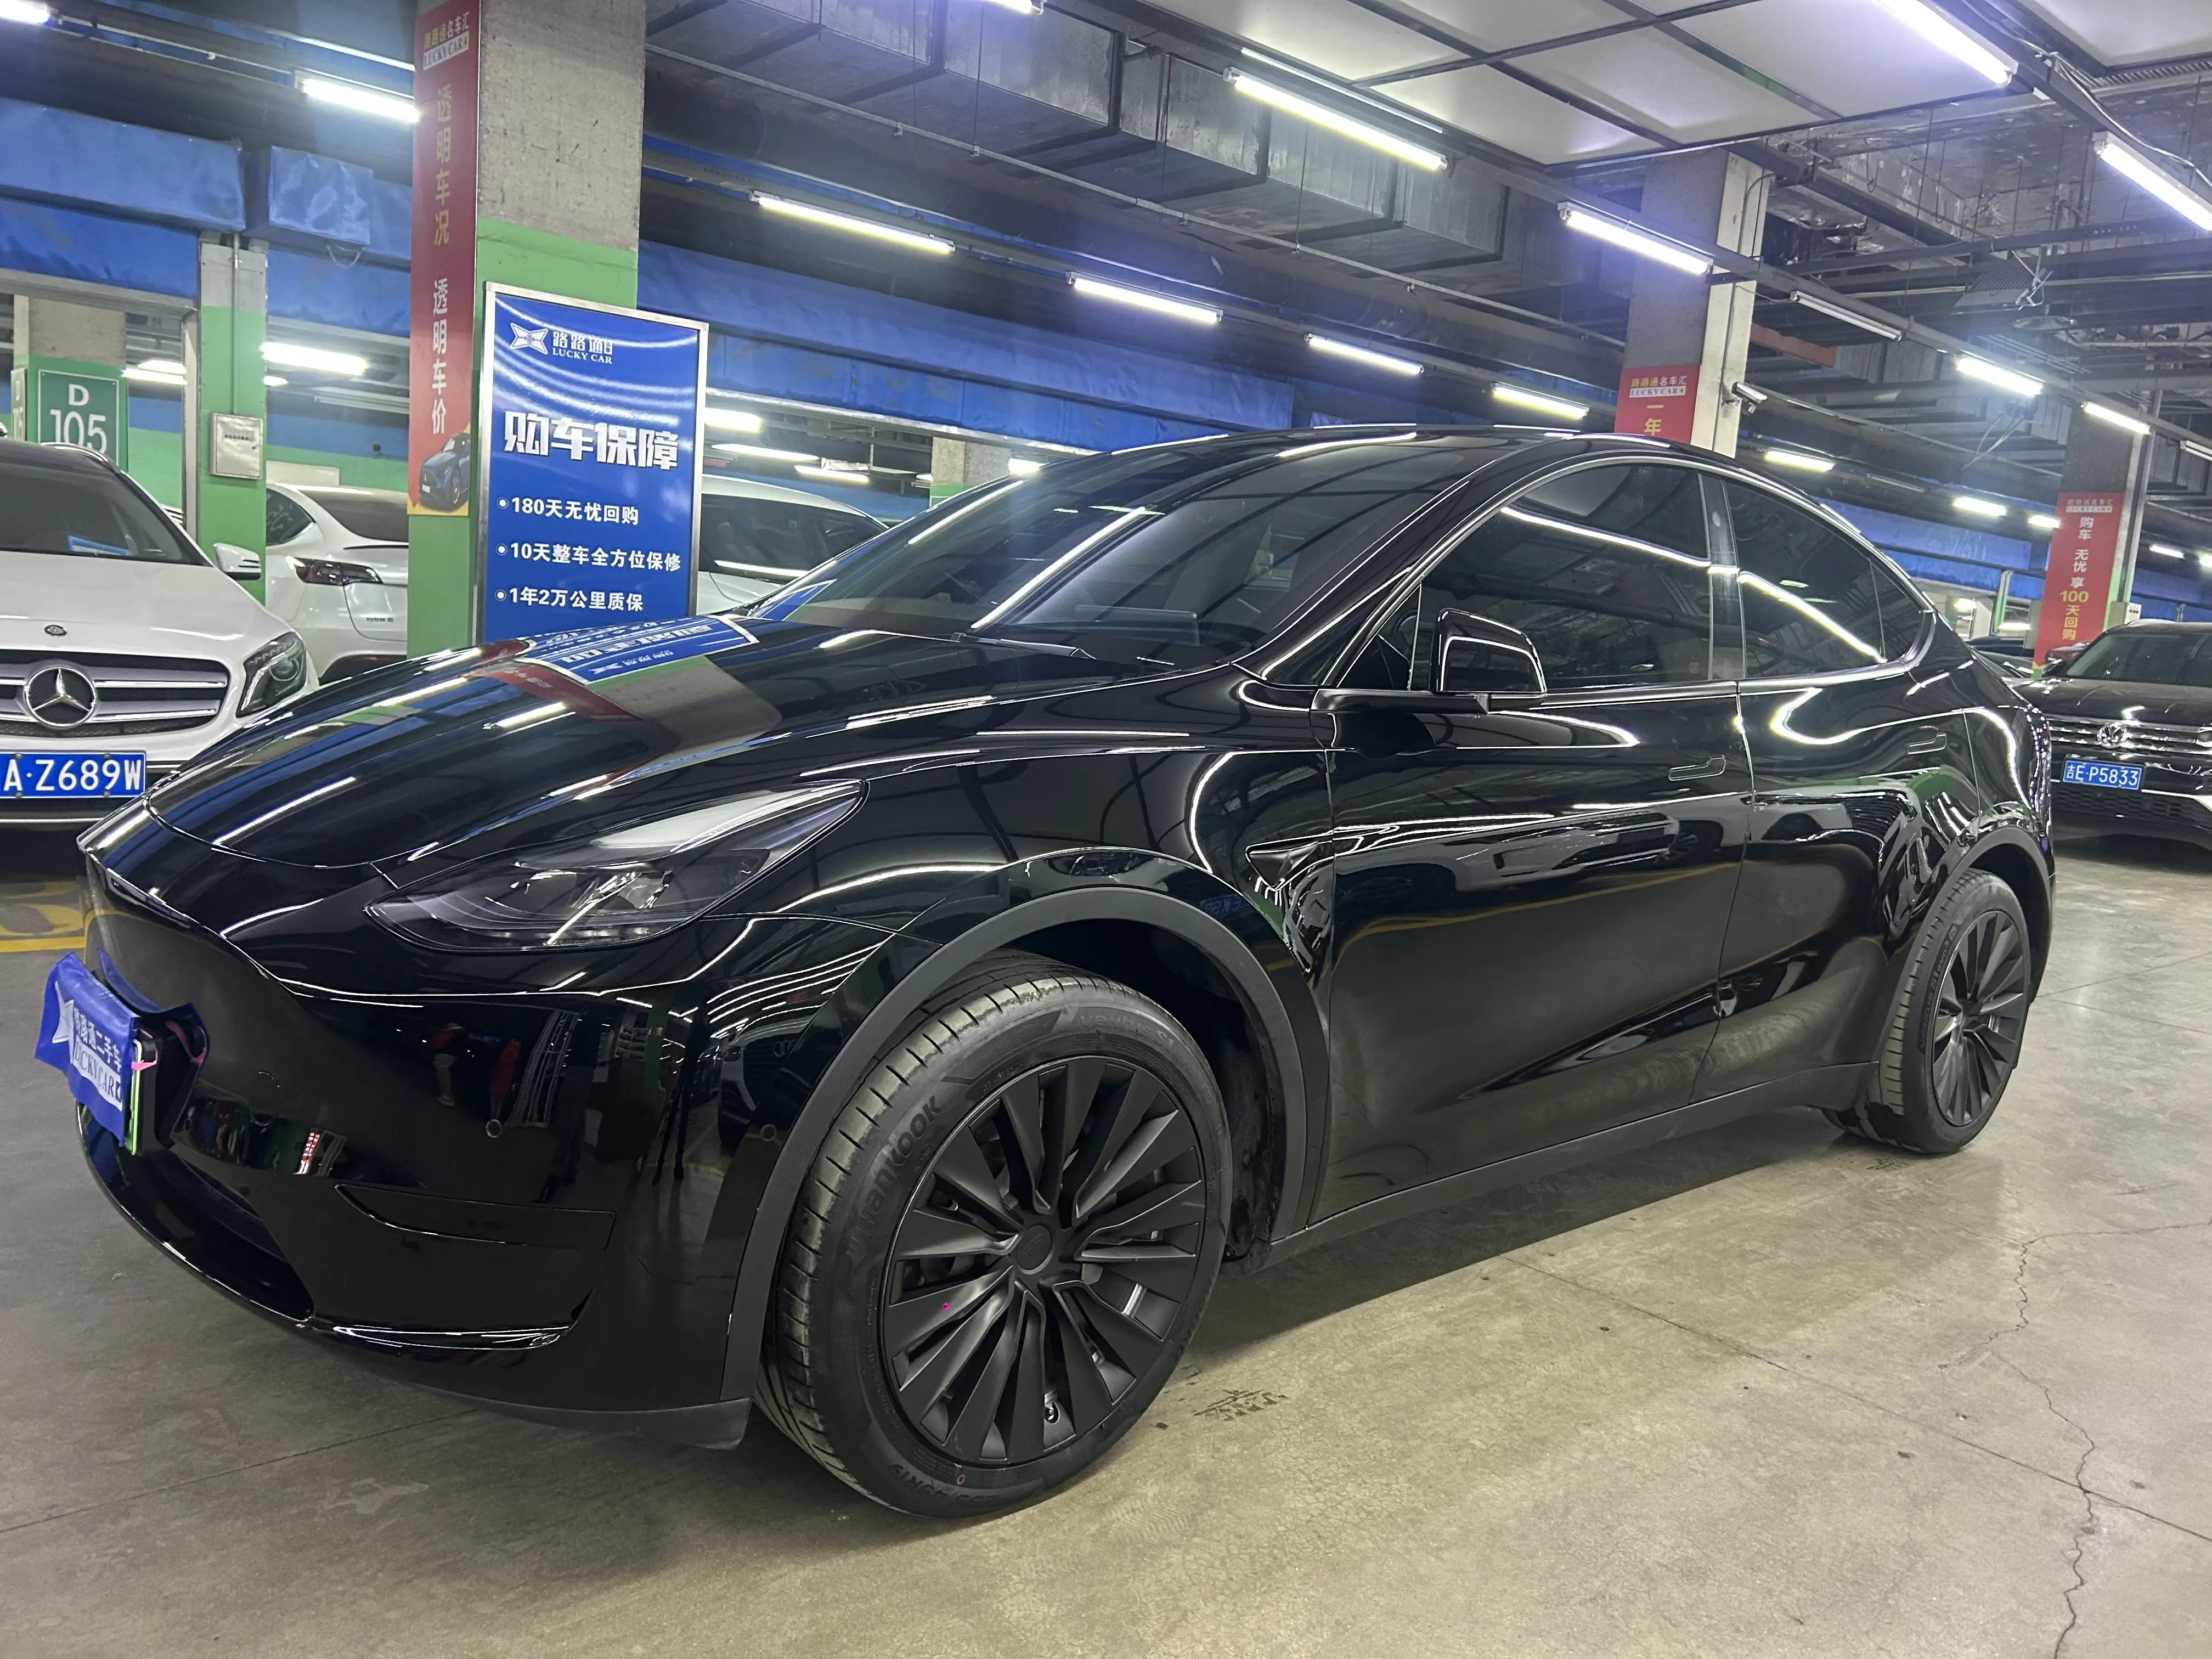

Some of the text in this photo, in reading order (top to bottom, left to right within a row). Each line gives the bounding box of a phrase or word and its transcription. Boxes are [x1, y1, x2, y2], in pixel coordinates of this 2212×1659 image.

[448, 37, 463, 55] CAR
[432, 83, 452, 434] 透明车况 透明车价
[552, 347, 612, 364] LUCKY CAR
[69, 384, 89, 406] D
[1661, 387, 1678, 396] CAR
[50, 409, 106, 454] 105
[1644, 404, 1664, 436] 一年
[504, 410, 679, 470] 购车保障
[511, 496, 639, 526] 180天无忧回购
[510, 543, 681, 572] 10天整车全方位保修
[510, 586, 643, 612] 1年2万公里质保
